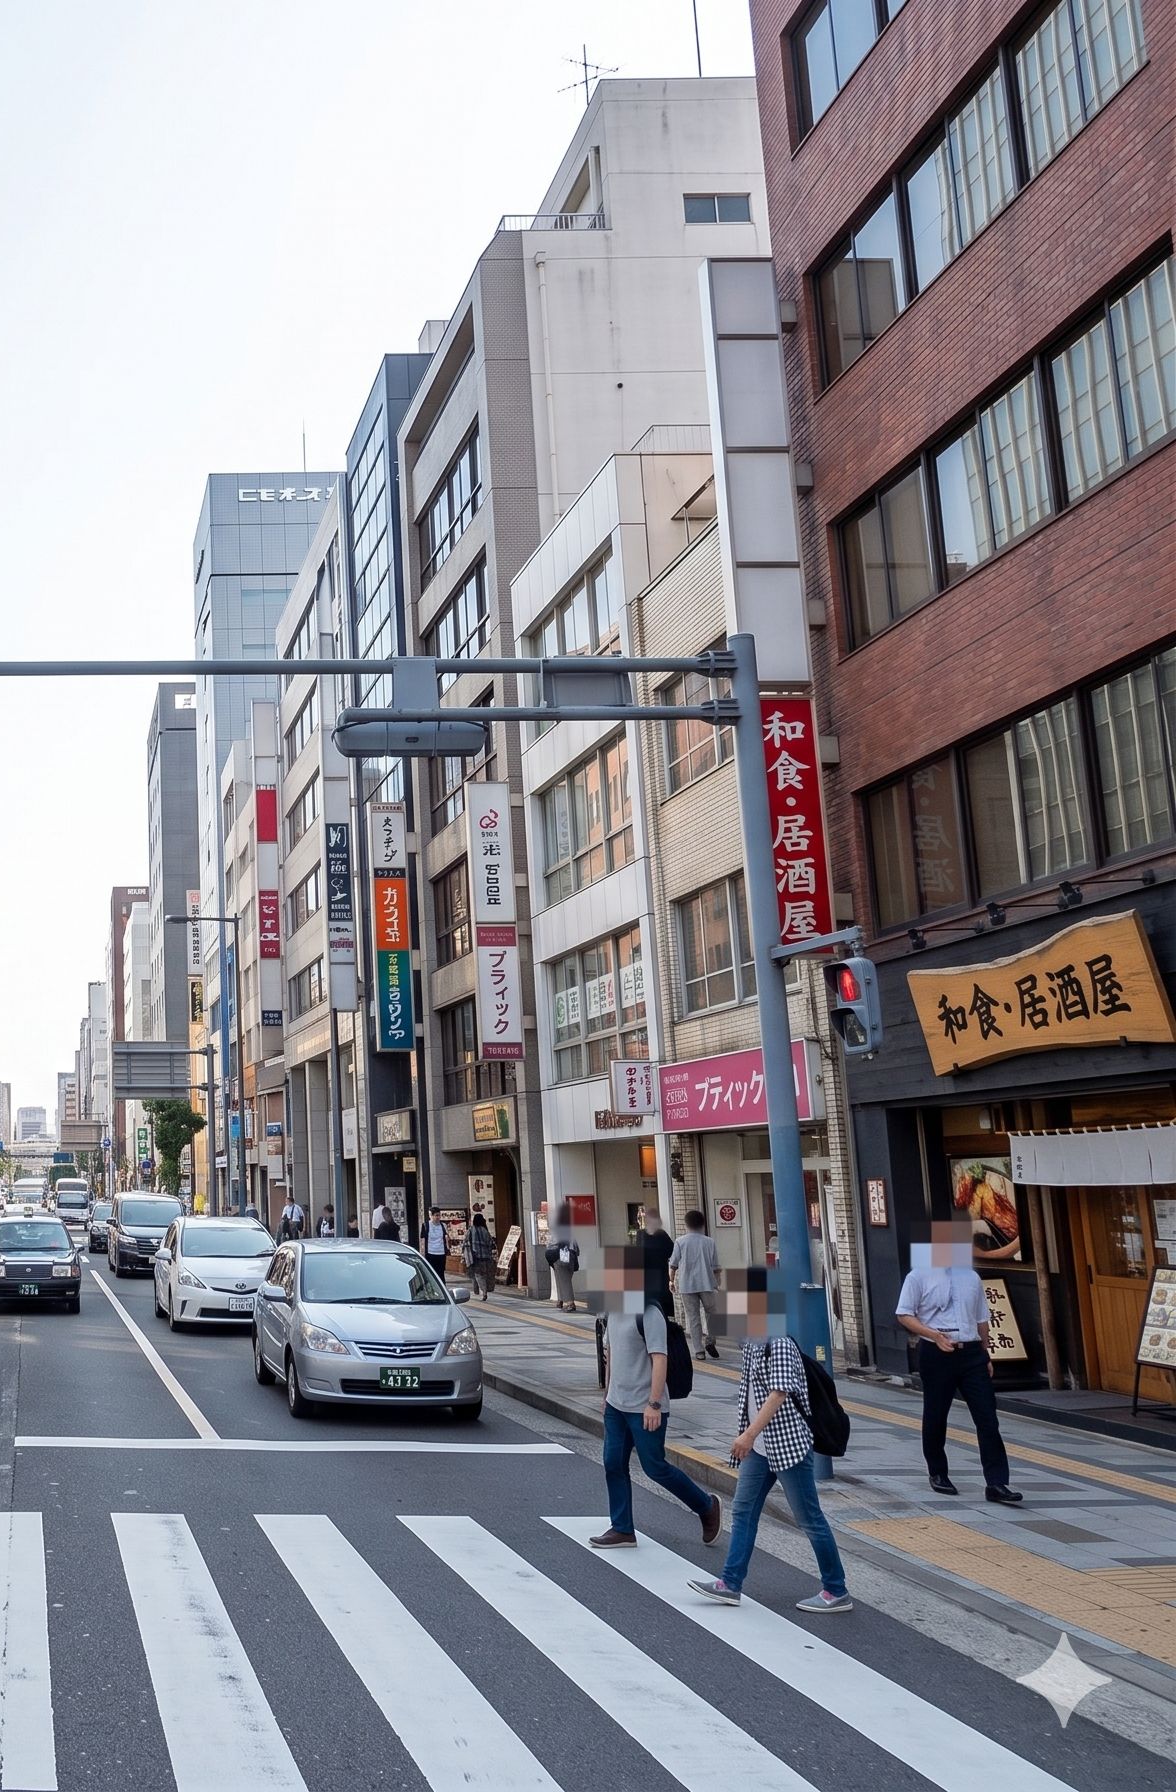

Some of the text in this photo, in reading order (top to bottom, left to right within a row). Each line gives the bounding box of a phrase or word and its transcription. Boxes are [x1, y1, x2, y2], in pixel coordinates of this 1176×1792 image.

[763, 711, 823, 940] 和食・居酒屋
[938, 953, 1132, 1045] 和食・居酒屋
